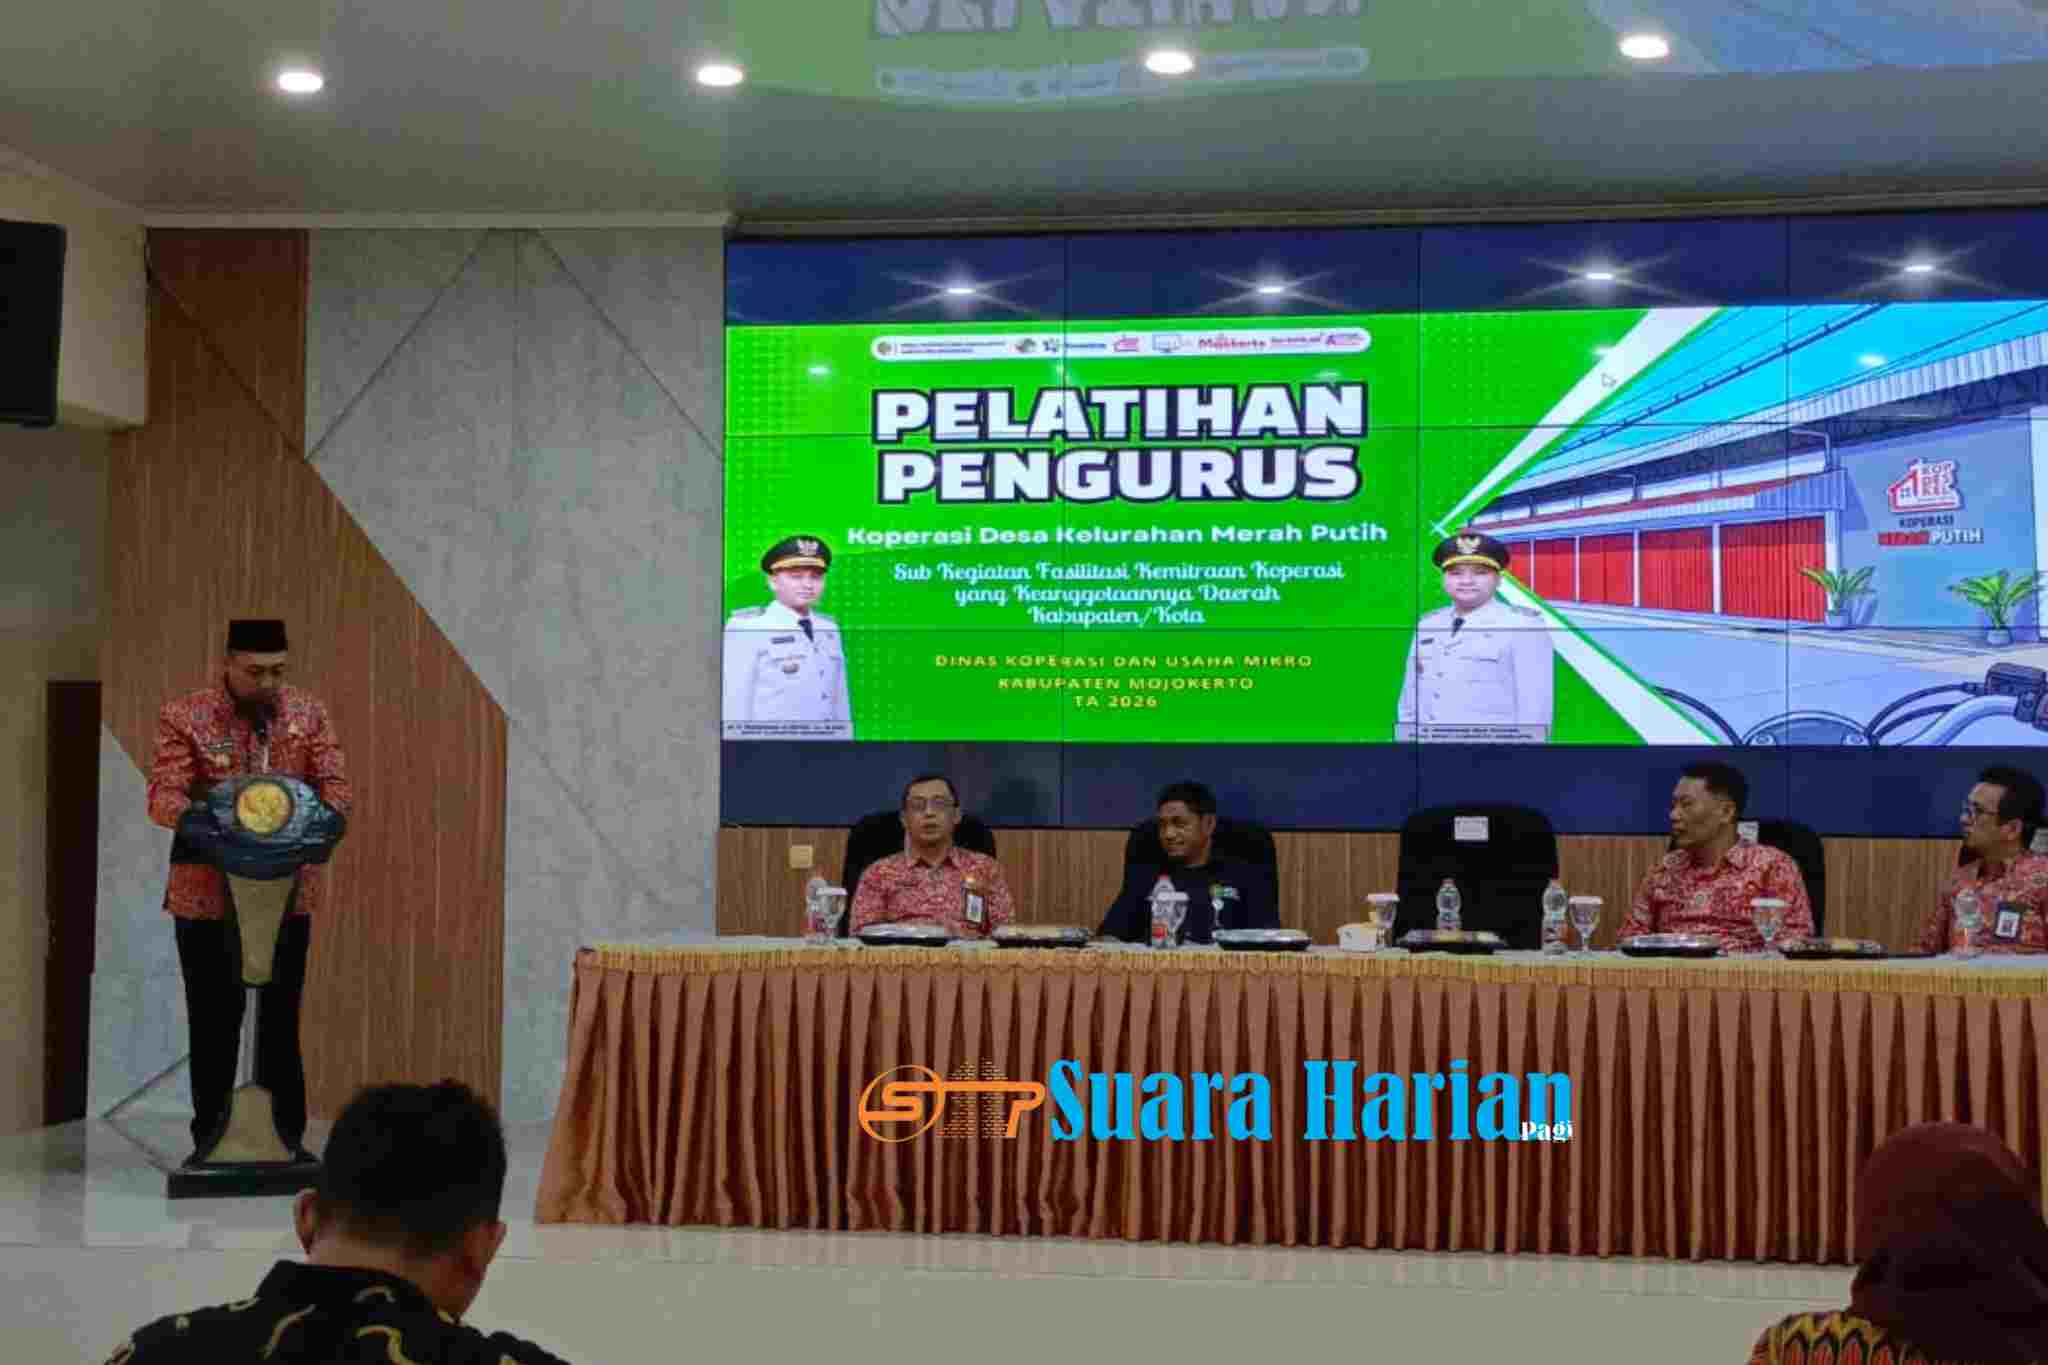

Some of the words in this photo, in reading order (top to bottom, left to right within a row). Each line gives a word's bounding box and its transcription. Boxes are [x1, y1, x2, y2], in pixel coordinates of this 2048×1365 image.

[875, 384, 1364, 442] PELATIHAN
[880, 445, 1360, 502] PENGURUS
[847, 527, 972, 548] Koperasi
[980, 527, 1049, 545] Desa
[1056, 526, 1203, 545] Kelurahan
[1211, 524, 1303, 543] Merah
[1310, 522, 1388, 542] Putih
[893, 563, 932, 581] Sub
[936, 562, 1032, 585] Kegiatan
[1134, 561, 1248, 580] Kemitraan
[1251, 560, 1345, 583] Koperasi
[954, 588, 1009, 607] yang
[1199, 584, 1281, 602] Daerah
[935, 655, 997, 667] DINAS
[1006, 655, 1105, 668] KOPERASI
[1113, 655, 1157, 668] DAN
[1166, 655, 1234, 668] USAHA
[1243, 655, 1312, 667] MIKRO
[998, 678, 1120, 689] KABUPATEN
[1129, 678, 1254, 690] MOJOKERTO
[1075, 695, 1099, 707] TA
[1108, 695, 1158, 708] 2026
